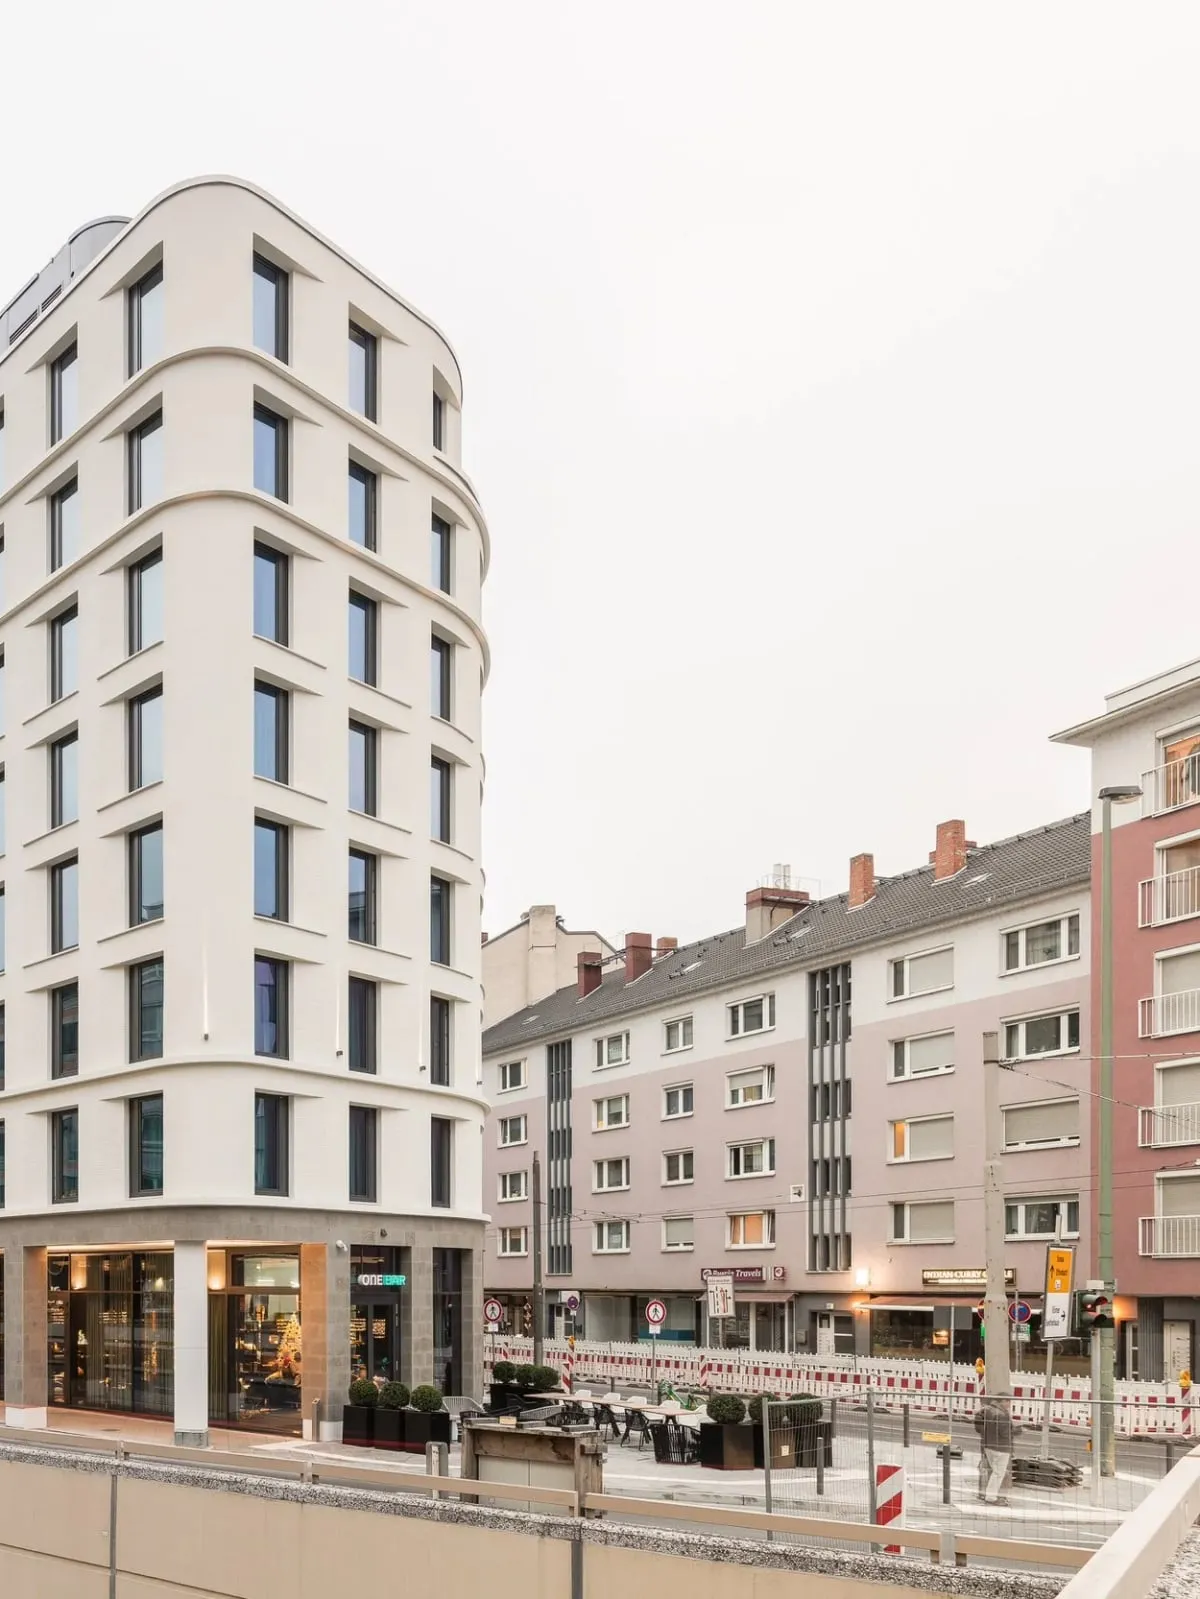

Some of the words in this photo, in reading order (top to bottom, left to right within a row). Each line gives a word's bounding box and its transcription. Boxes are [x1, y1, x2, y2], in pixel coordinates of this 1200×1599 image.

[735, 1269, 761, 1277] Travels
[923, 1270, 953, 1279] INDIAN
[954, 1270, 982, 1279] CURRY
[362, 1274, 383, 1286] ONE
[385, 1274, 406, 1286] BAR
